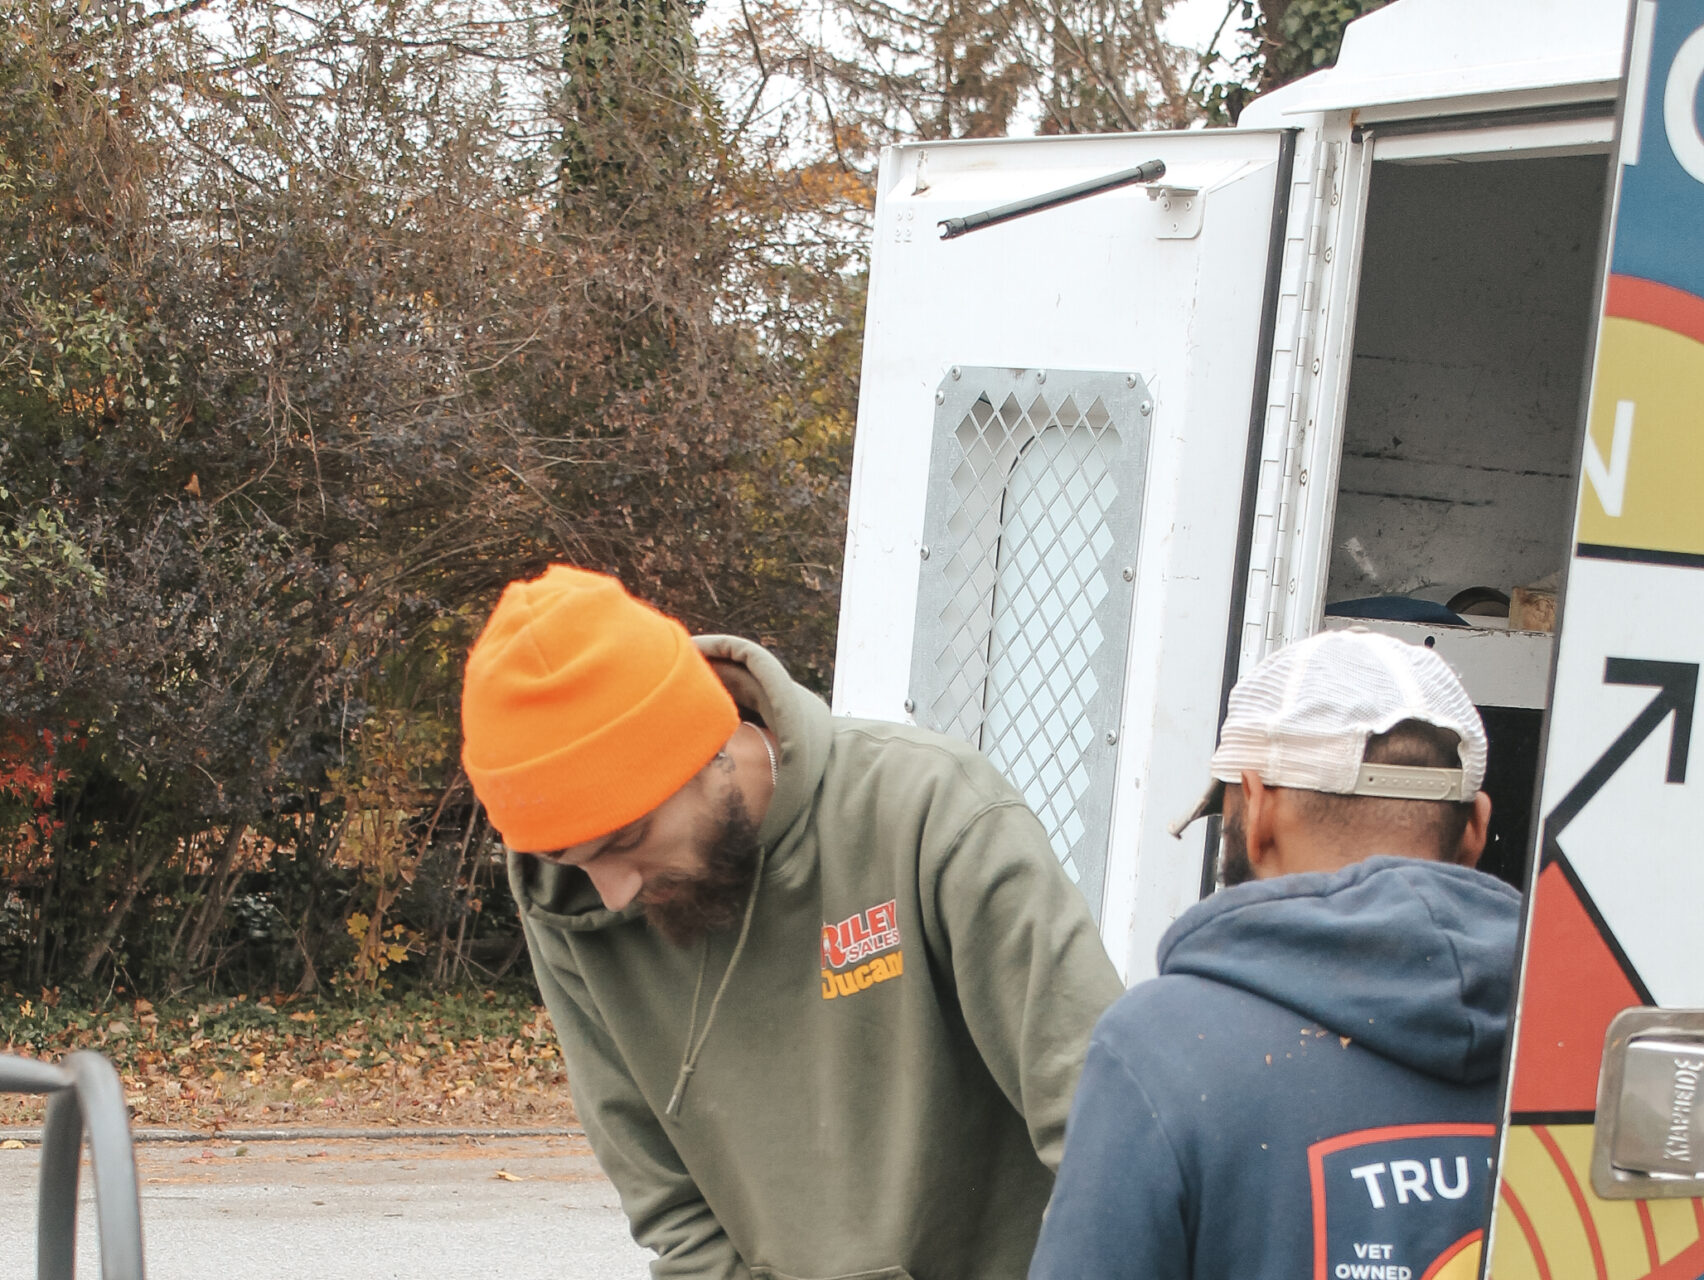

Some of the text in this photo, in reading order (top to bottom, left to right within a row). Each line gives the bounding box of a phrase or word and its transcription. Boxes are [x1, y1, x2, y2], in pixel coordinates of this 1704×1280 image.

[821, 899, 897, 969] RILEY
[847, 929, 900, 962] SALES
[1350, 1156, 1469, 1209] TRU
[1353, 1242, 1393, 1260] VET
